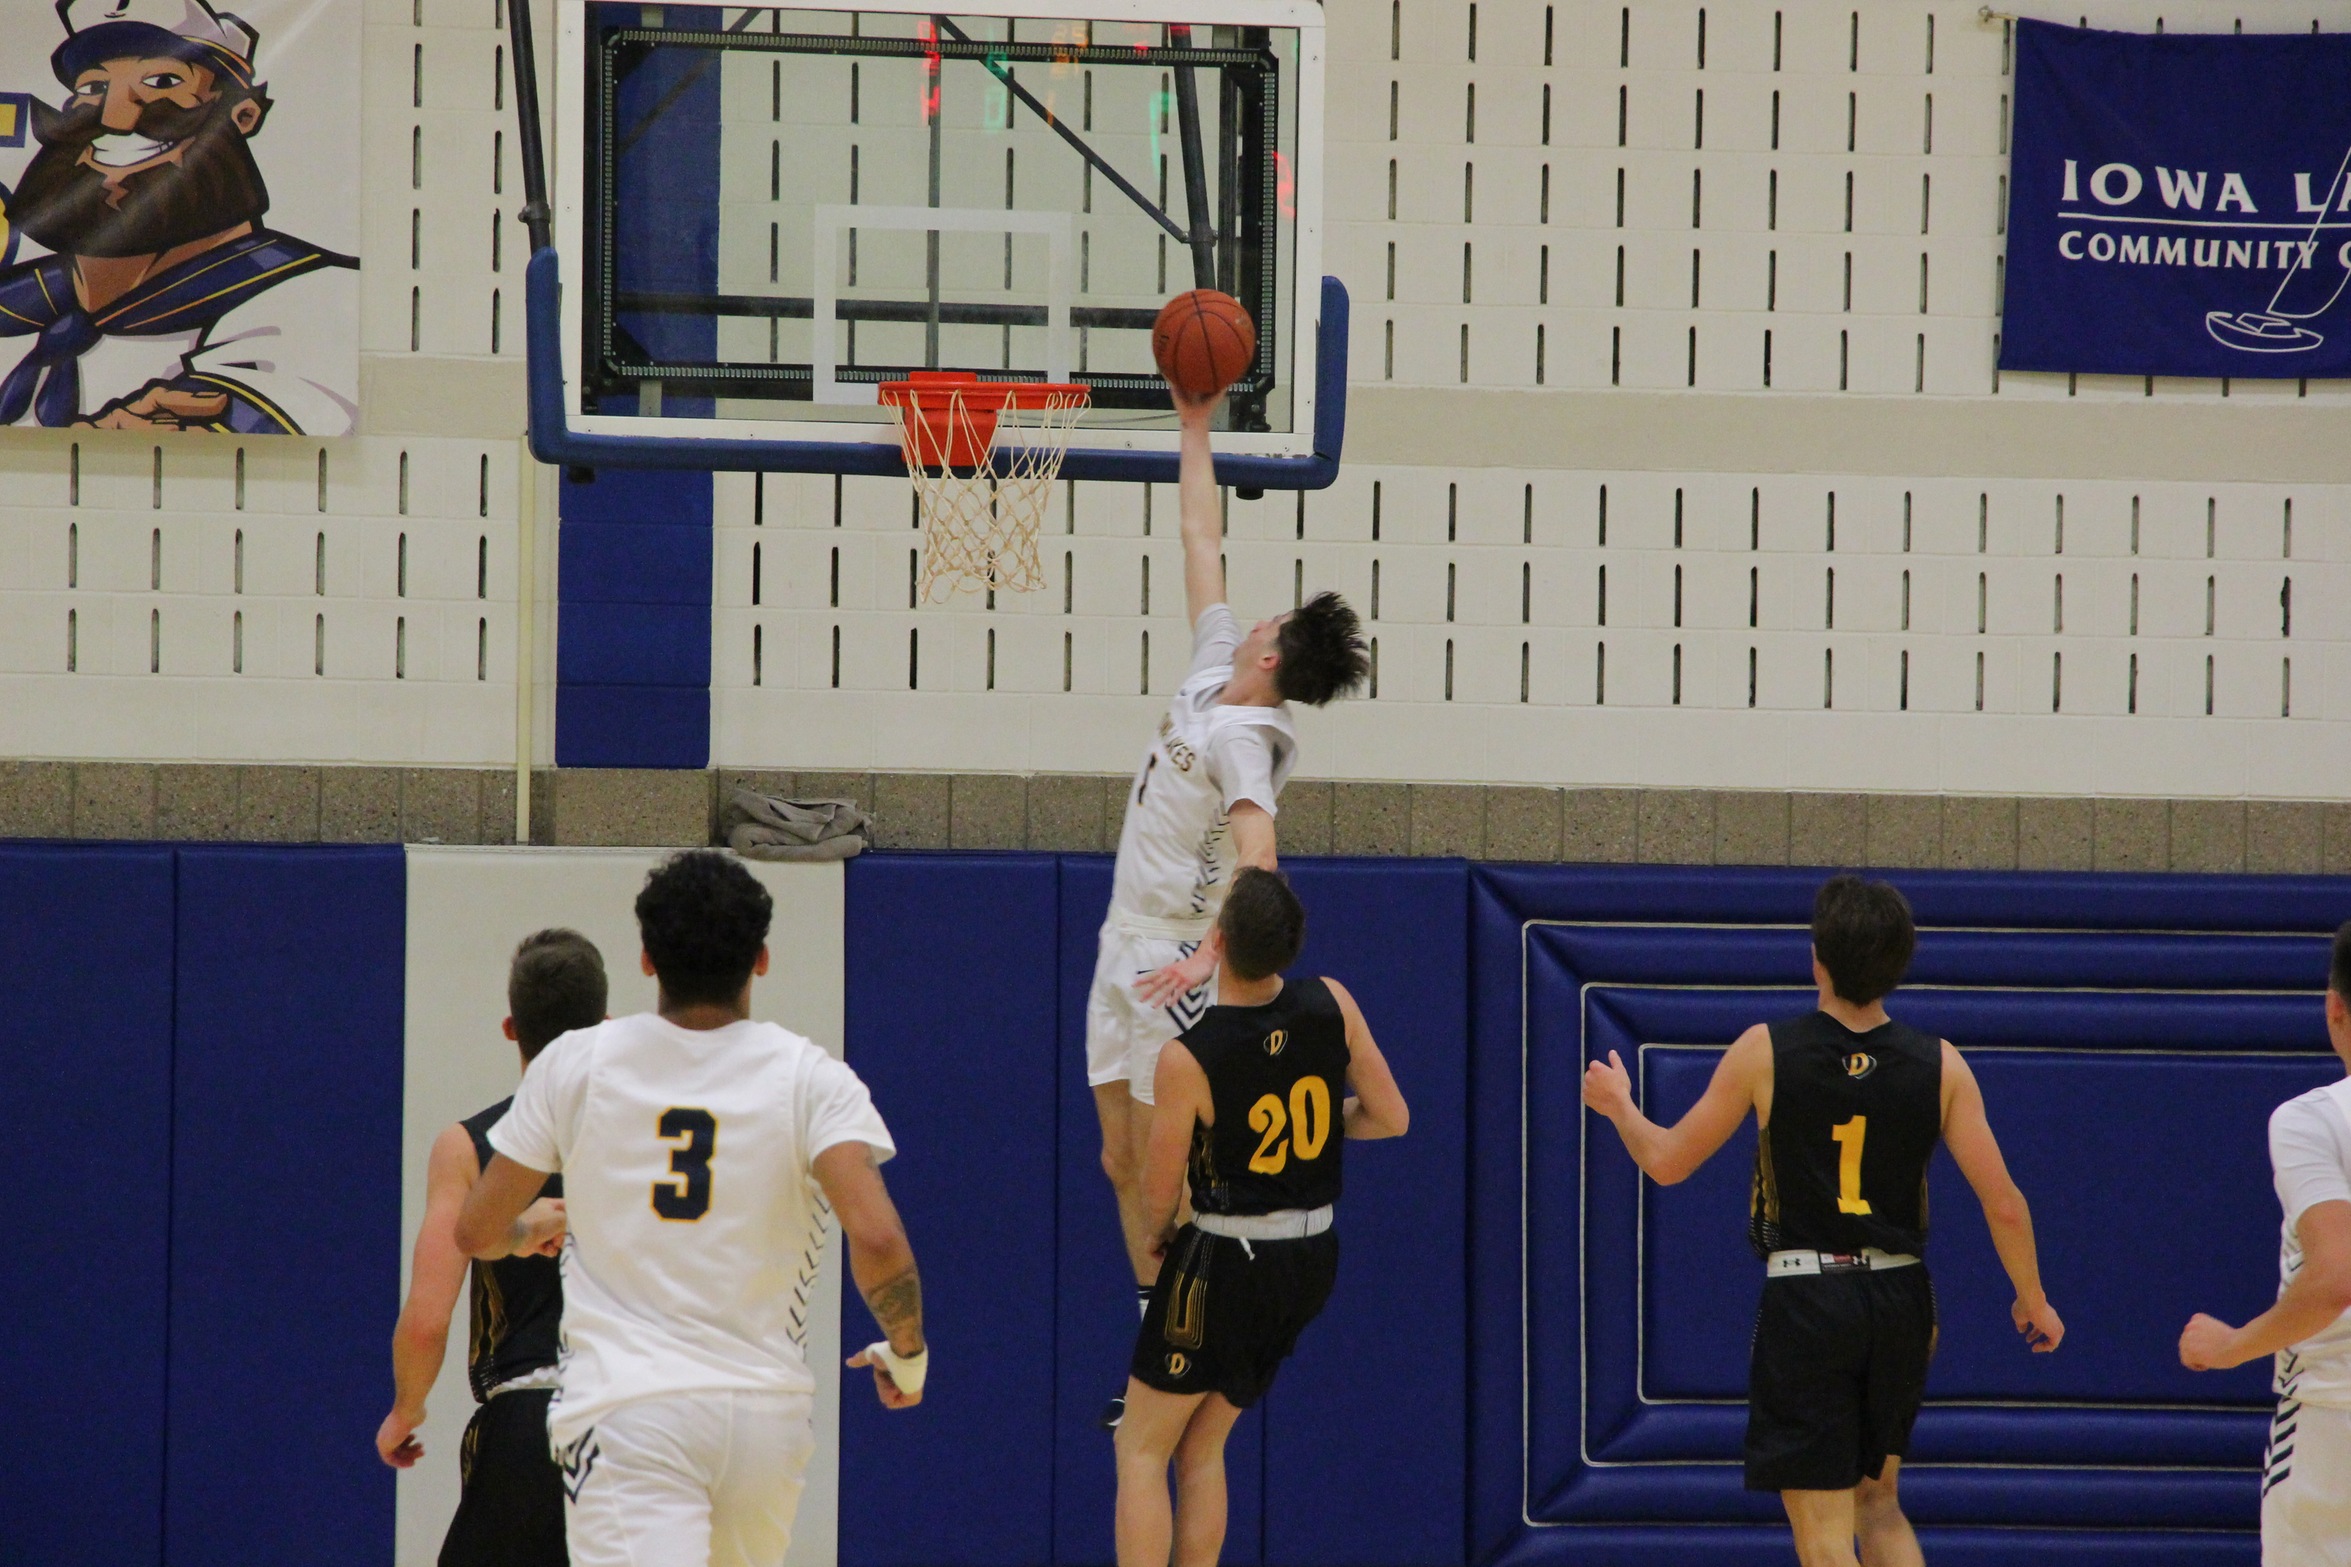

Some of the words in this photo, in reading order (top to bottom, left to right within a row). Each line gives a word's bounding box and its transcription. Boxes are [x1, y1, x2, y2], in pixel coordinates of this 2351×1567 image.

[2062, 159, 2258, 213] IOWA
[2058, 230, 2319, 269] COMMUNITY
[651, 1106, 719, 1222] 3
[1247, 1075, 1330, 1175] 20
[1831, 1115, 1872, 1215] 1
